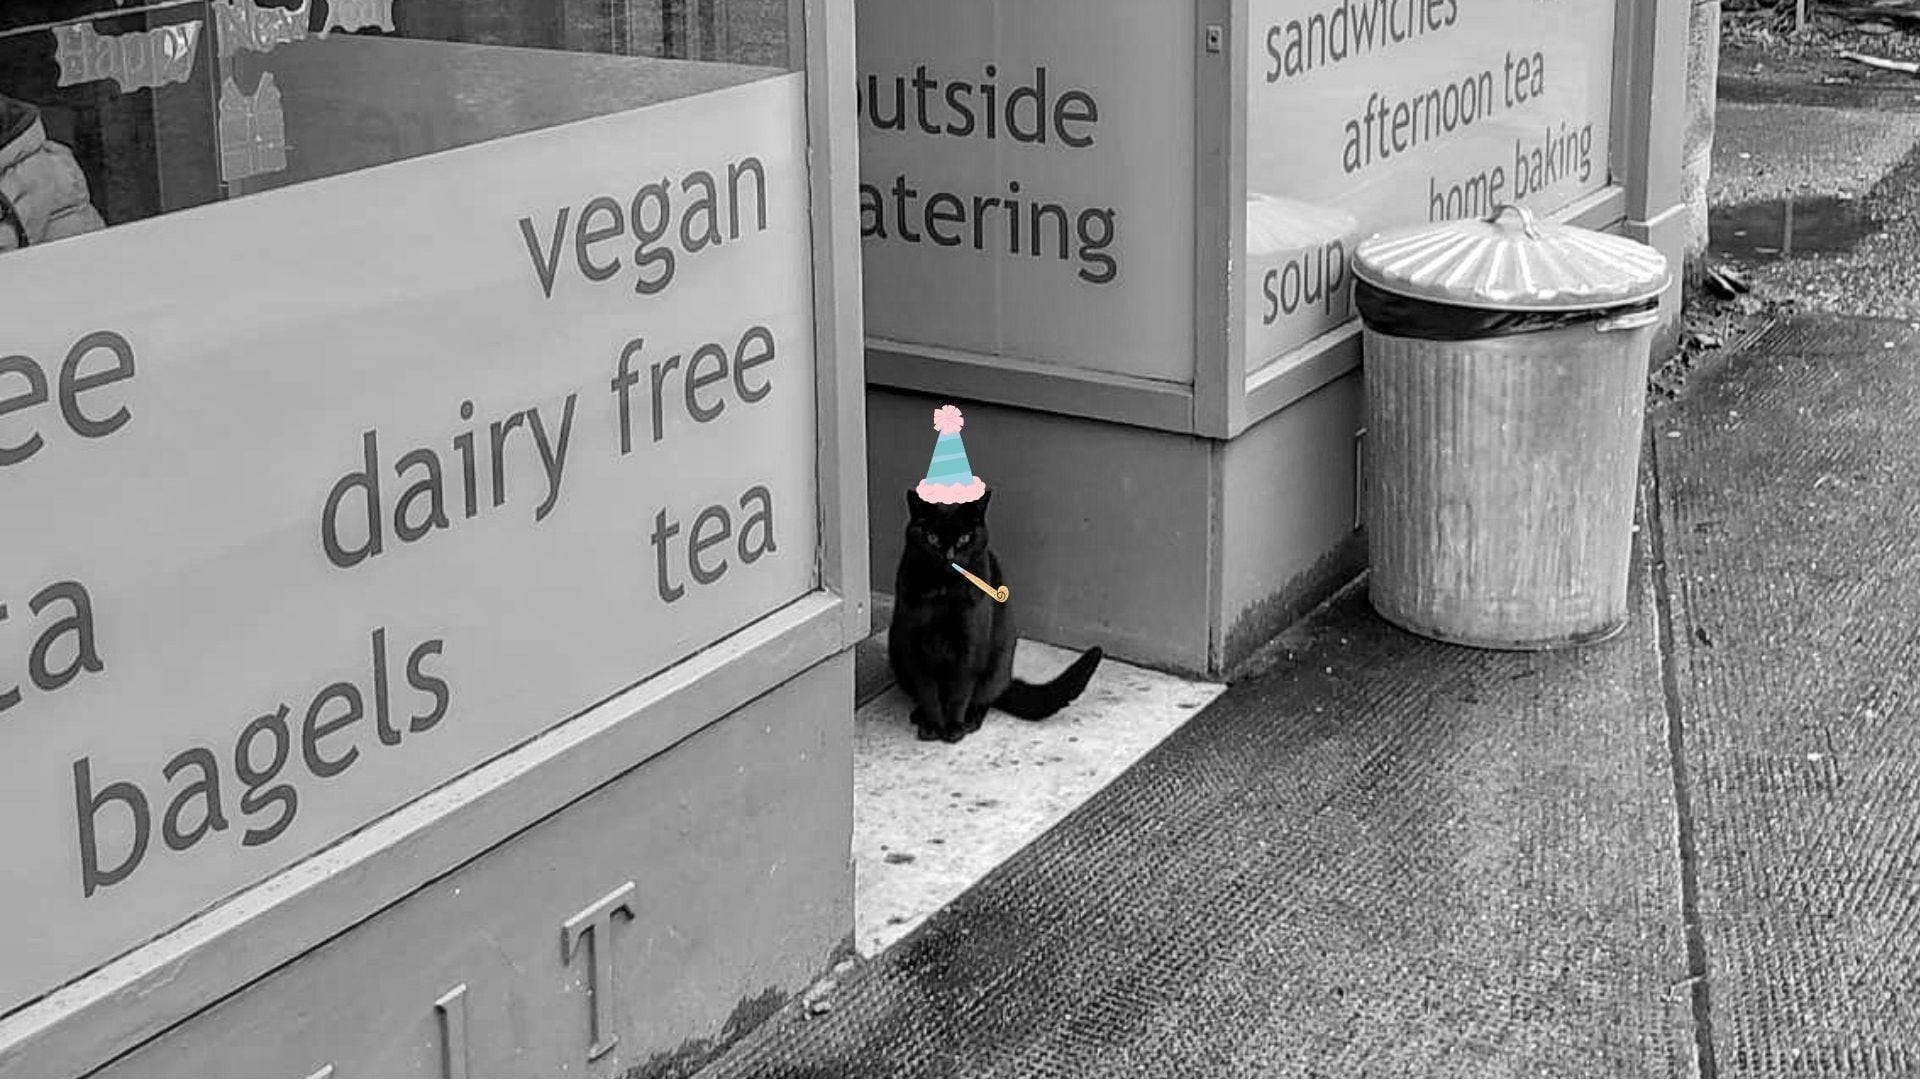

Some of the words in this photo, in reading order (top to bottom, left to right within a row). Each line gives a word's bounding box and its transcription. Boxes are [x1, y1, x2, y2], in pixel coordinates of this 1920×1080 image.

[1265, 0, 1458, 84] sandwiches
[857, 65, 1099, 148] utside
[1343, 71, 1492, 174] afternoon
[1504, 51, 1544, 108] tea
[519, 156, 767, 299] vegan
[859, 174, 1118, 284] atering
[1429, 165, 1505, 222] home
[1514, 121, 1592, 202] baking
[1262, 239, 1345, 325] soup
[321, 394, 577, 569] dairy
[611, 326, 775, 456] free
[650, 485, 776, 603] tea
[0, 580, 104, 713] a
[73, 627, 450, 898] bagels
